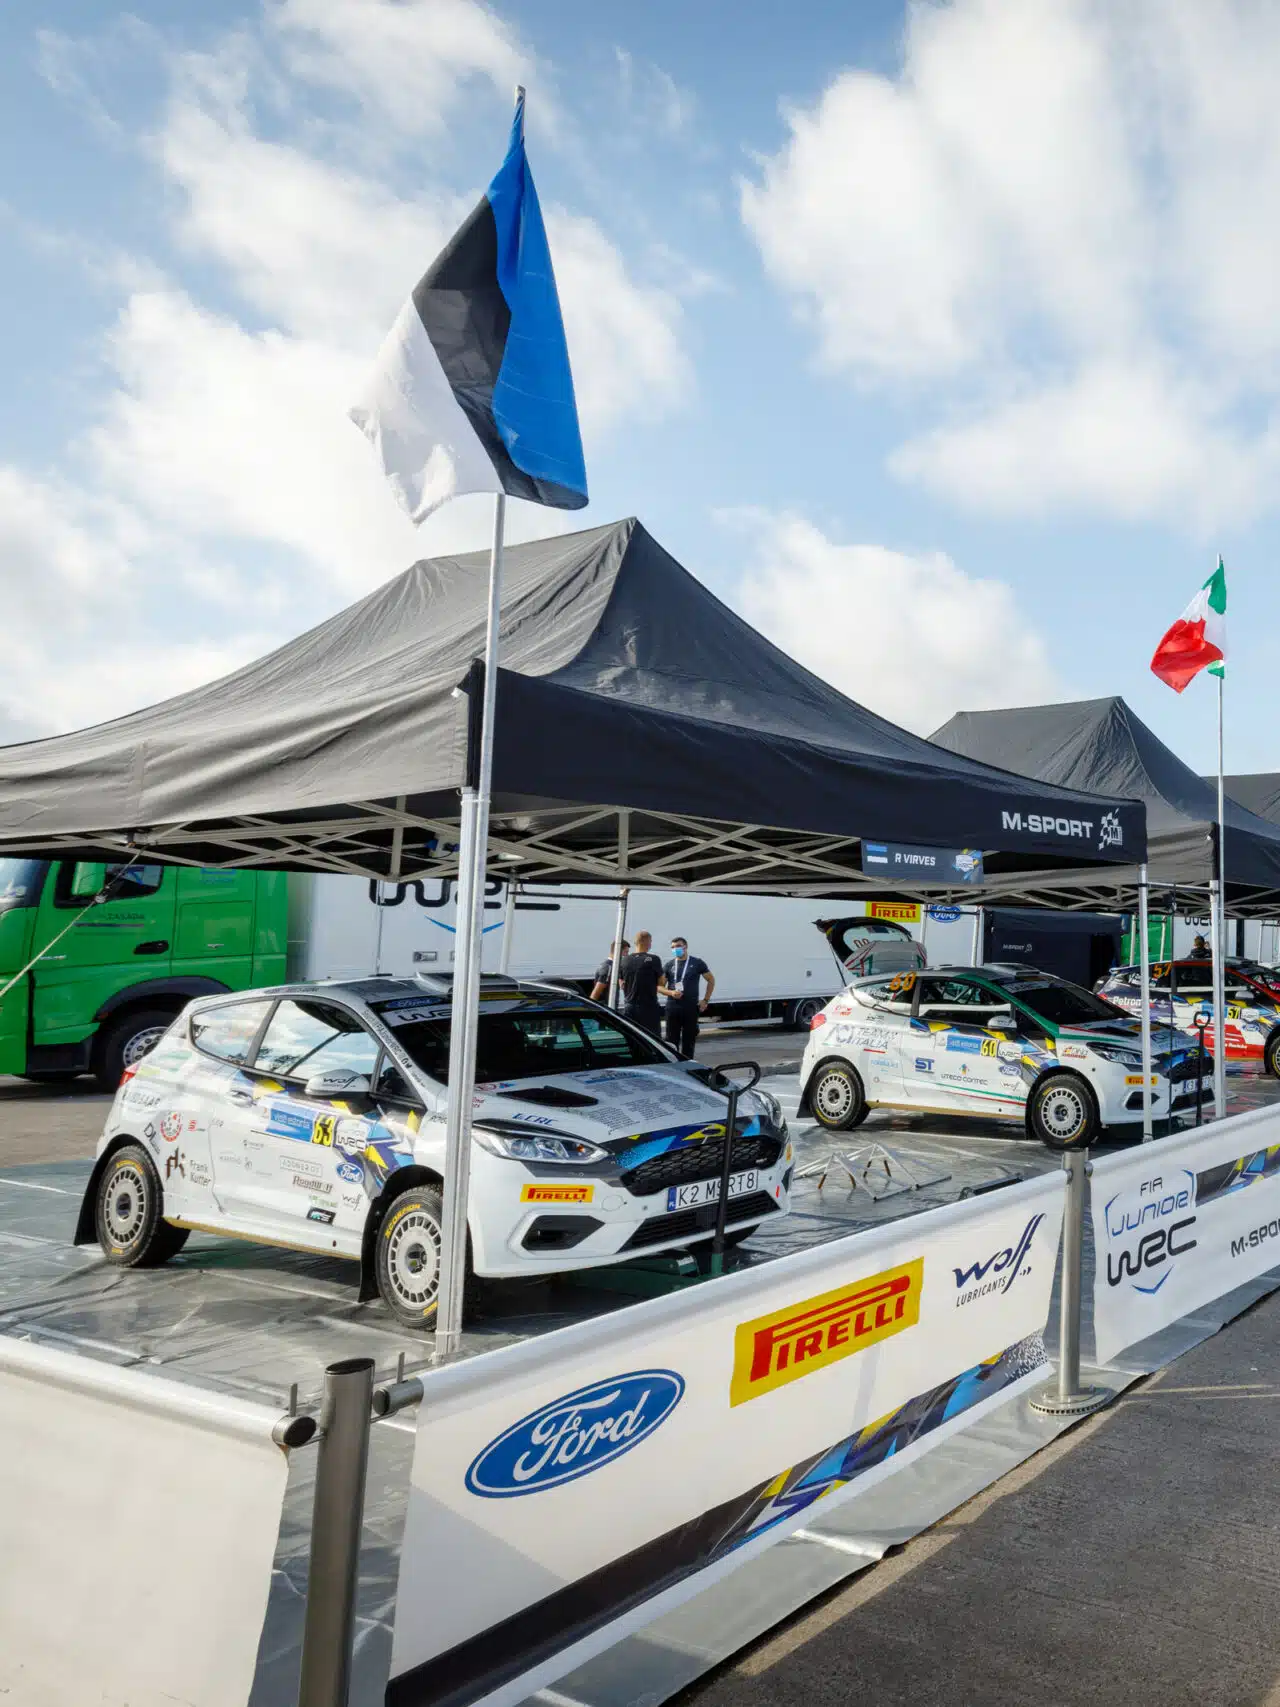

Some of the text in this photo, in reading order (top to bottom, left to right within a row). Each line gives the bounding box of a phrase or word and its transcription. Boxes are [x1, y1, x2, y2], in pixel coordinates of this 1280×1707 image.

[1002, 811, 1093, 838] M-SPORT
[895, 853, 936, 866] R VIRVES
[872, 903, 917, 918] PIRELLI
[1152, 962, 1173, 978] 57
[889, 971, 917, 991] 60
[1228, 1007, 1240, 1019] 57
[982, 1039, 997, 1057] 60
[915, 1058, 935, 1070] ST
[313, 1115, 335, 1146] 63
[340, 1165, 361, 1181] Ford
[528, 1187, 588, 1201] PIRELLI
[678, 1184, 700, 1207] K2
[1140, 1177, 1163, 1196] FIA
[1111, 1190, 1189, 1237] JUNIOR
[952, 1213, 1045, 1295] wolf
[1107, 1216, 1197, 1287] WRC
[956, 1275, 1007, 1308] LUBRICANTS
[750, 1275, 910, 1383] PIRELLI
[512, 1389, 652, 1480] Ford
